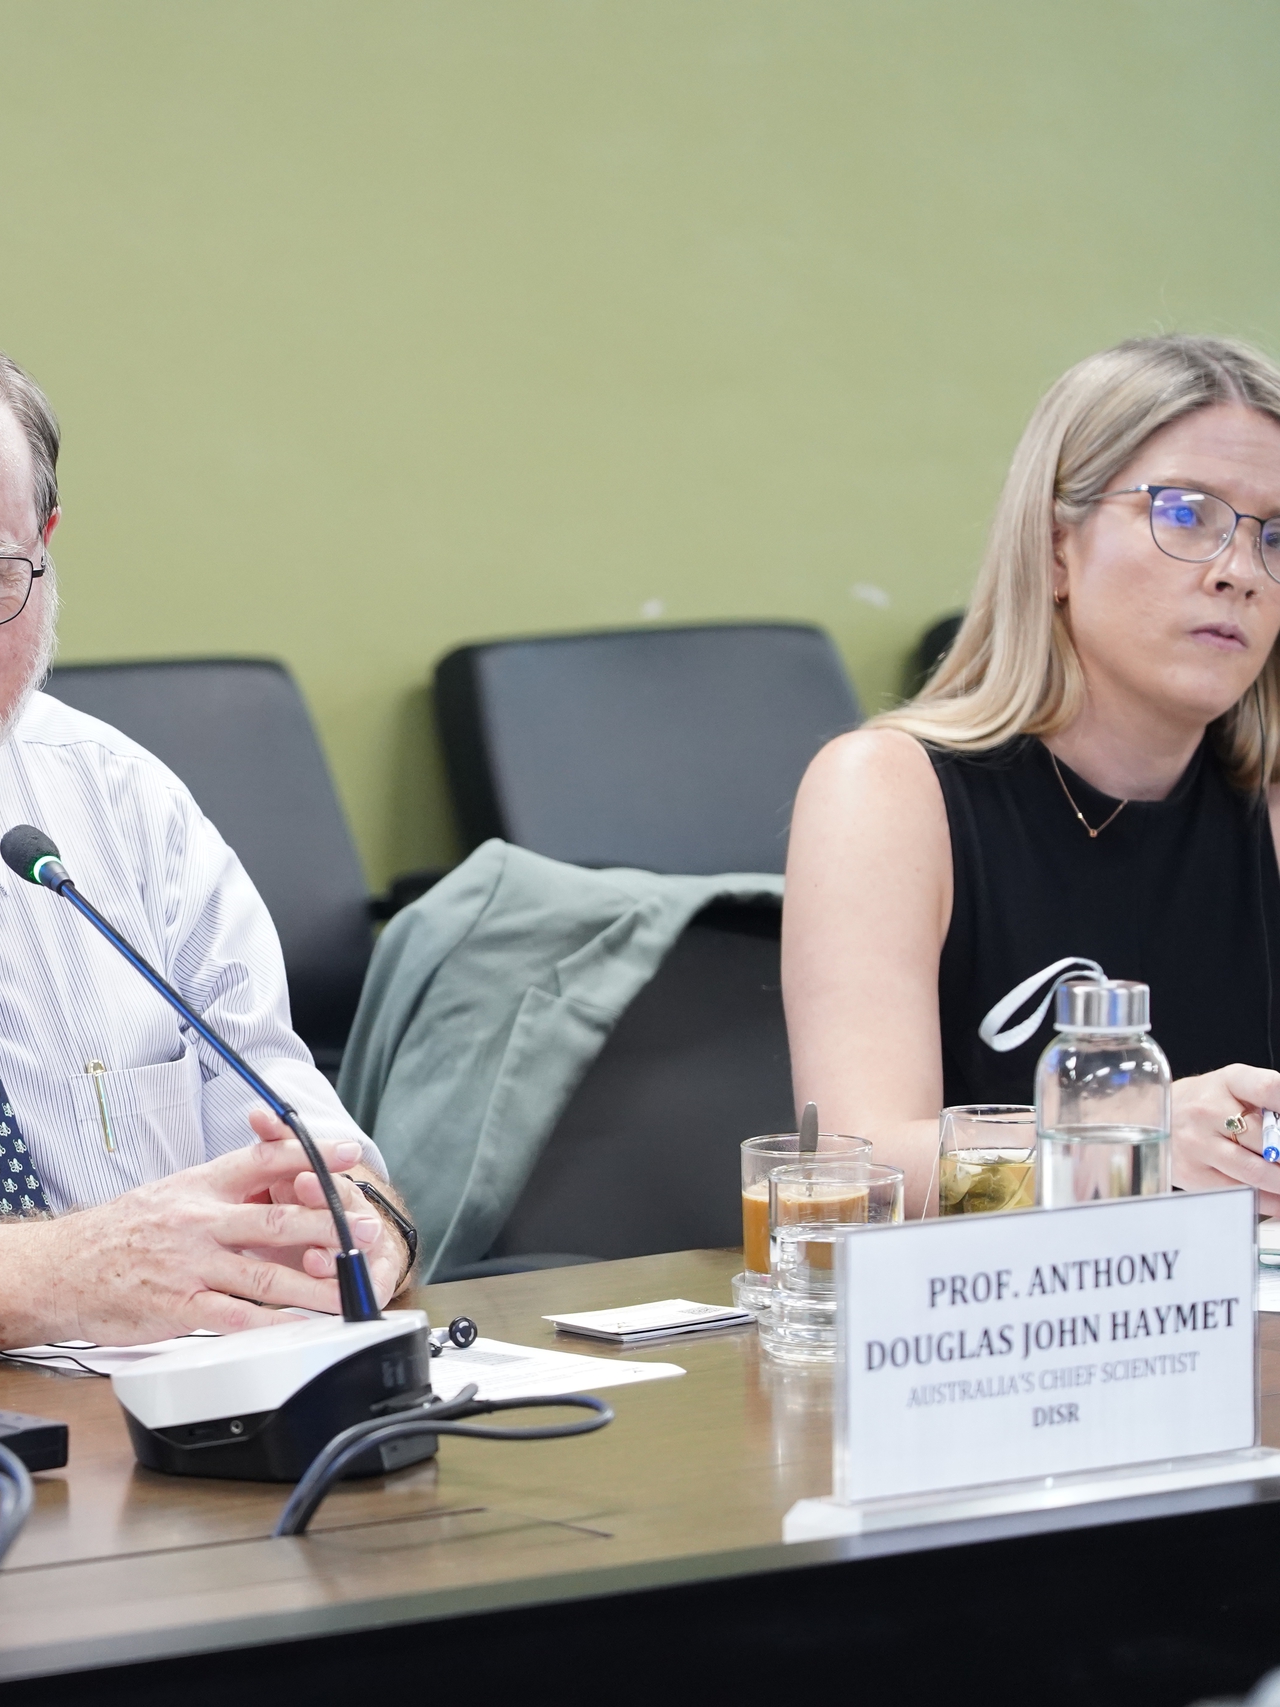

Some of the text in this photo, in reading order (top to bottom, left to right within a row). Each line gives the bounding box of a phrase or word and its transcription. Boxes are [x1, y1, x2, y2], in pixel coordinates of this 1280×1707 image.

[928, 1250, 1180, 1309] PROF. ANTHONY
[866, 1298, 1240, 1371] DOUGLAS JOHN HAYMET
[907, 1352, 1199, 1408] AUSTRALIA'S CHIEF SCIENTIST
[1032, 1403, 1080, 1428] DISR
